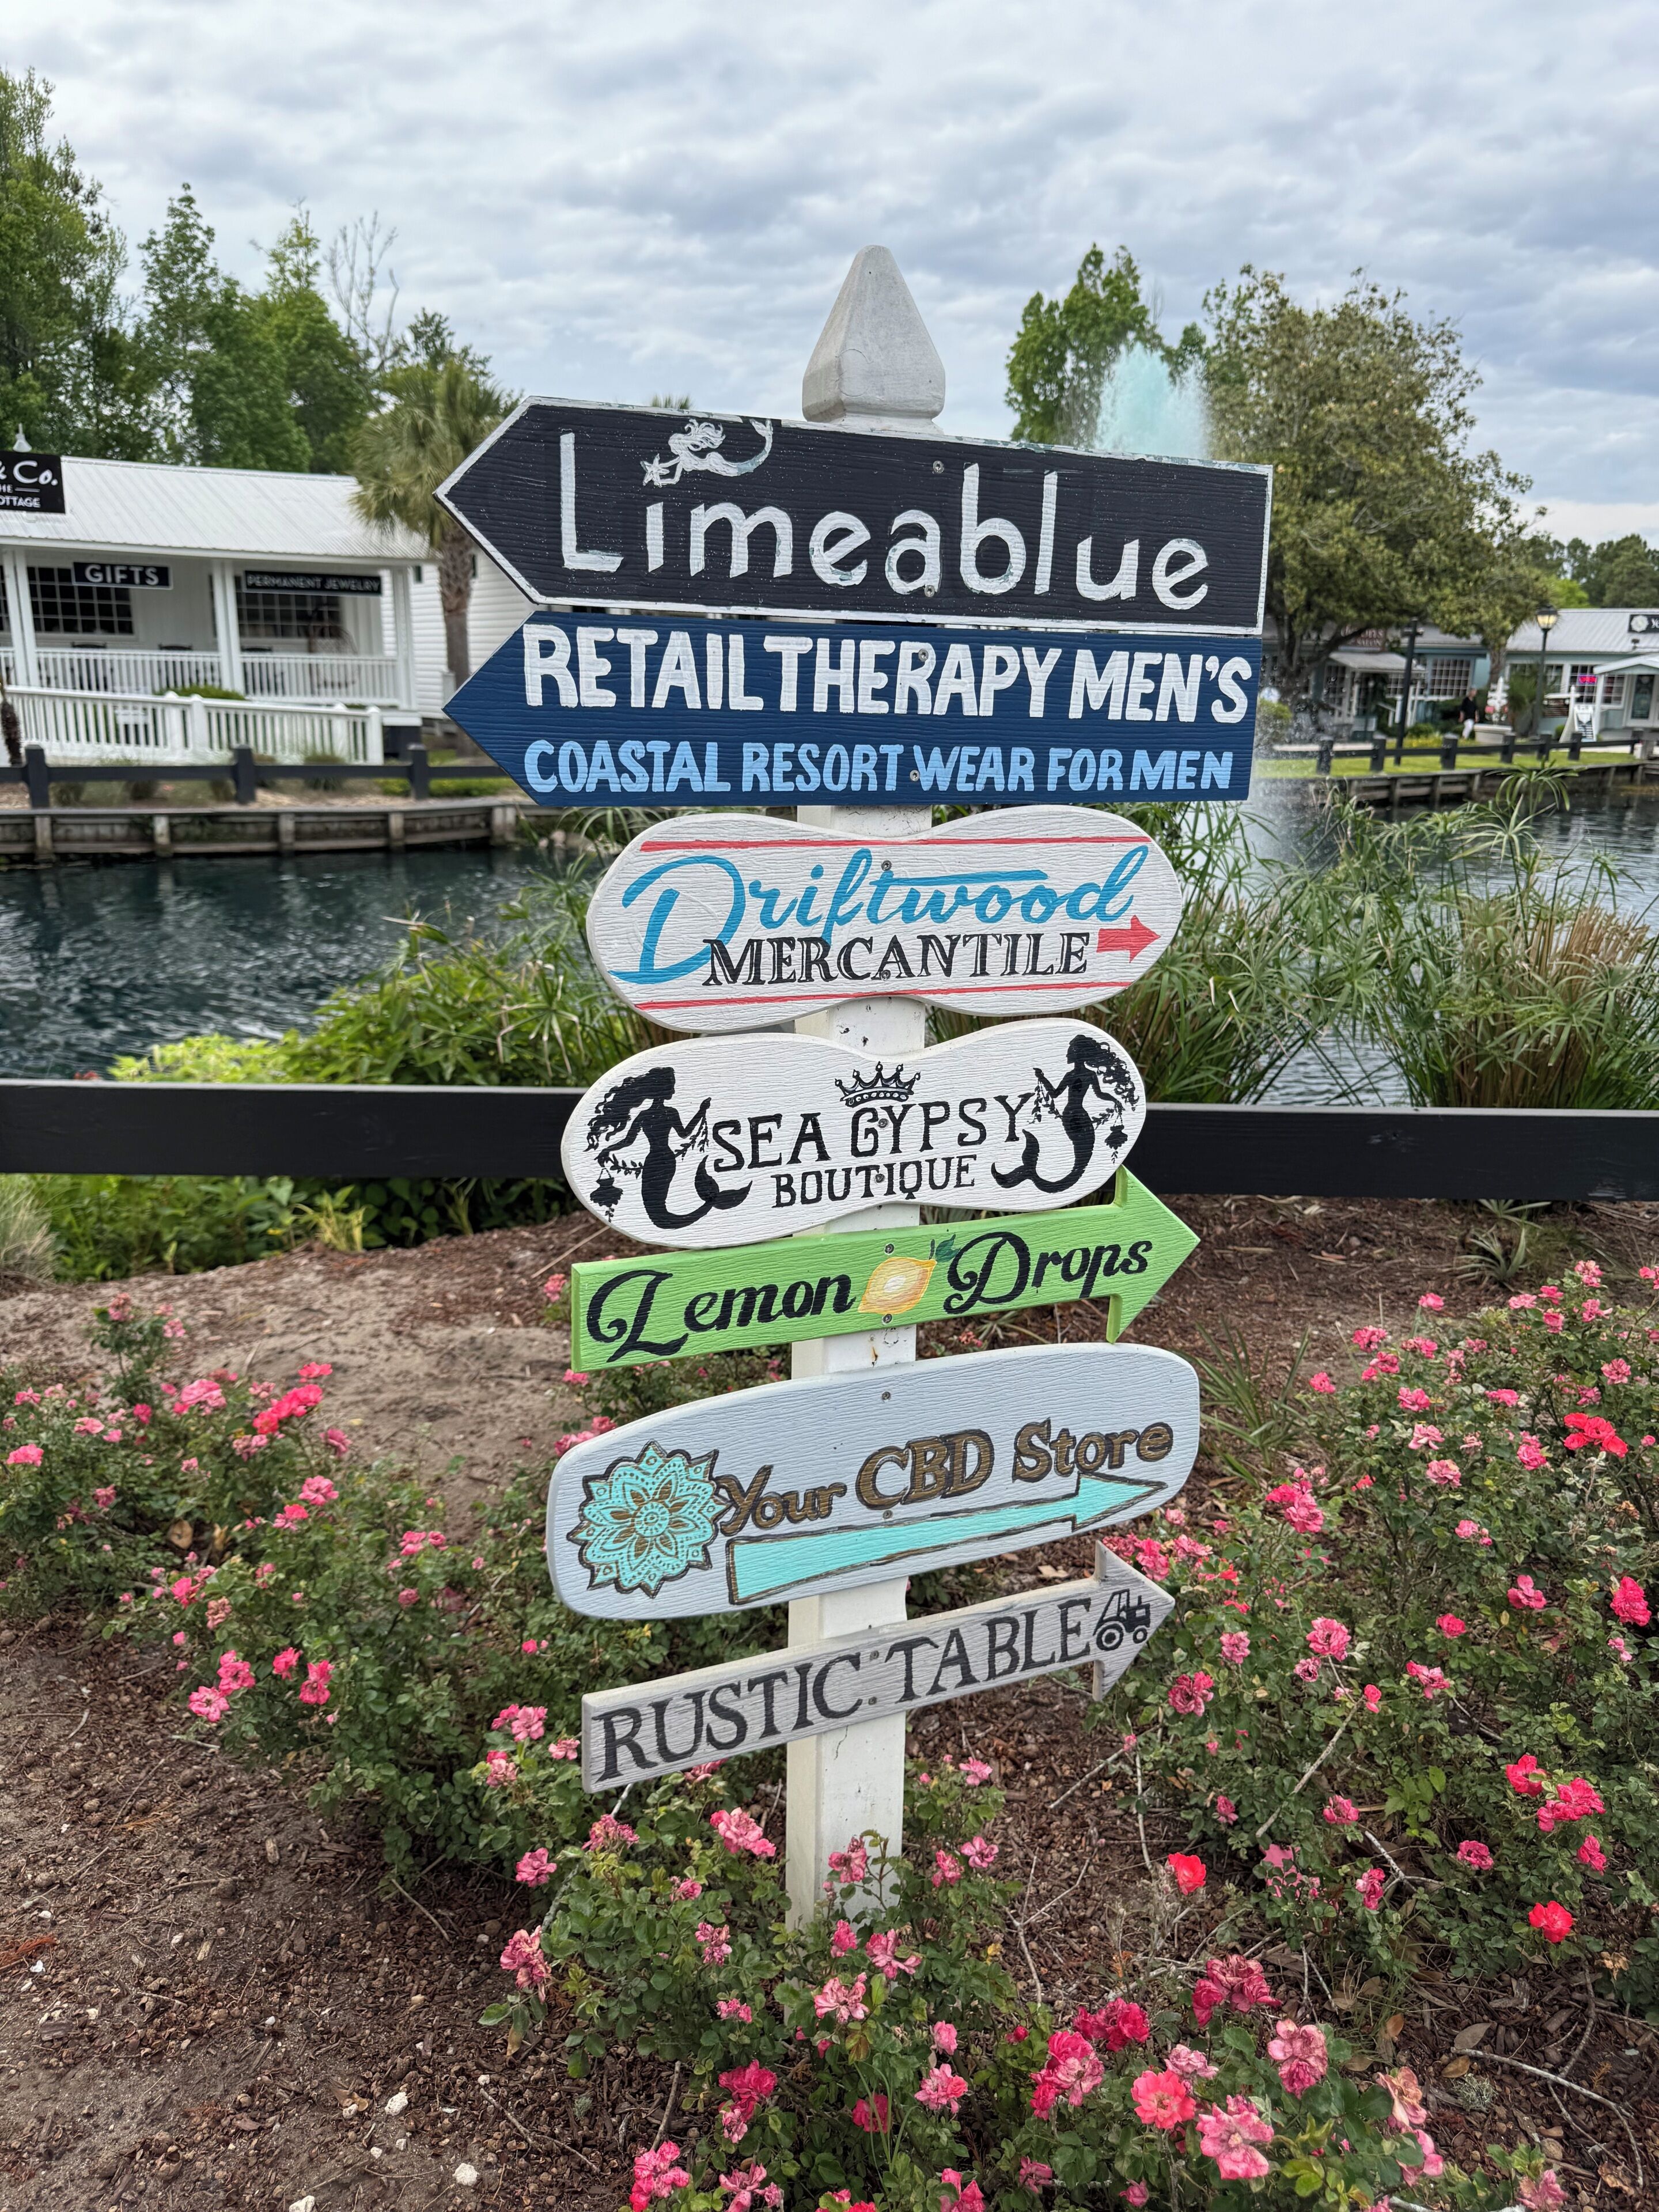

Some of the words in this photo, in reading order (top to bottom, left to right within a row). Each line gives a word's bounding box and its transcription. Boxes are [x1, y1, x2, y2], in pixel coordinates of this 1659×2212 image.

[13, 460, 58, 486] Co.
[559, 431, 1209, 611] Limeablue
[85, 563, 159, 586] GIFTS
[247, 575, 321, 589] PERMANENT
[325, 577, 380, 591] JEWELRY
[522, 624, 764, 711] RETAIL
[764, 635, 1062, 718] THERAPY
[1069, 649, 1253, 724] MEN'S
[524, 739, 731, 793] COASTAL
[741, 743, 904, 793] RESORT
[912, 745, 1035, 792] WEAR
[1047, 748, 1125, 792] FOR
[1130, 750, 1233, 790] MEN
[609, 844, 1150, 984] Driftwood
[701, 931, 1091, 987] MERCANTILE
[712, 1112, 831, 1172] SEA
[850, 1092, 1040, 1158] GYPSY
[771, 1154, 977, 1209] BOUTIQUE
[586, 1269, 855, 1363] Lemon
[943, 1231, 1153, 1315] Drops
[718, 1465, 847, 1535] Your
[855, 1429, 995, 1510] CBD
[1012, 1418, 1175, 1484] Store
[597, 1652, 863, 1783] RUSTIC
[884, 1597, 1093, 1702] TABLE
